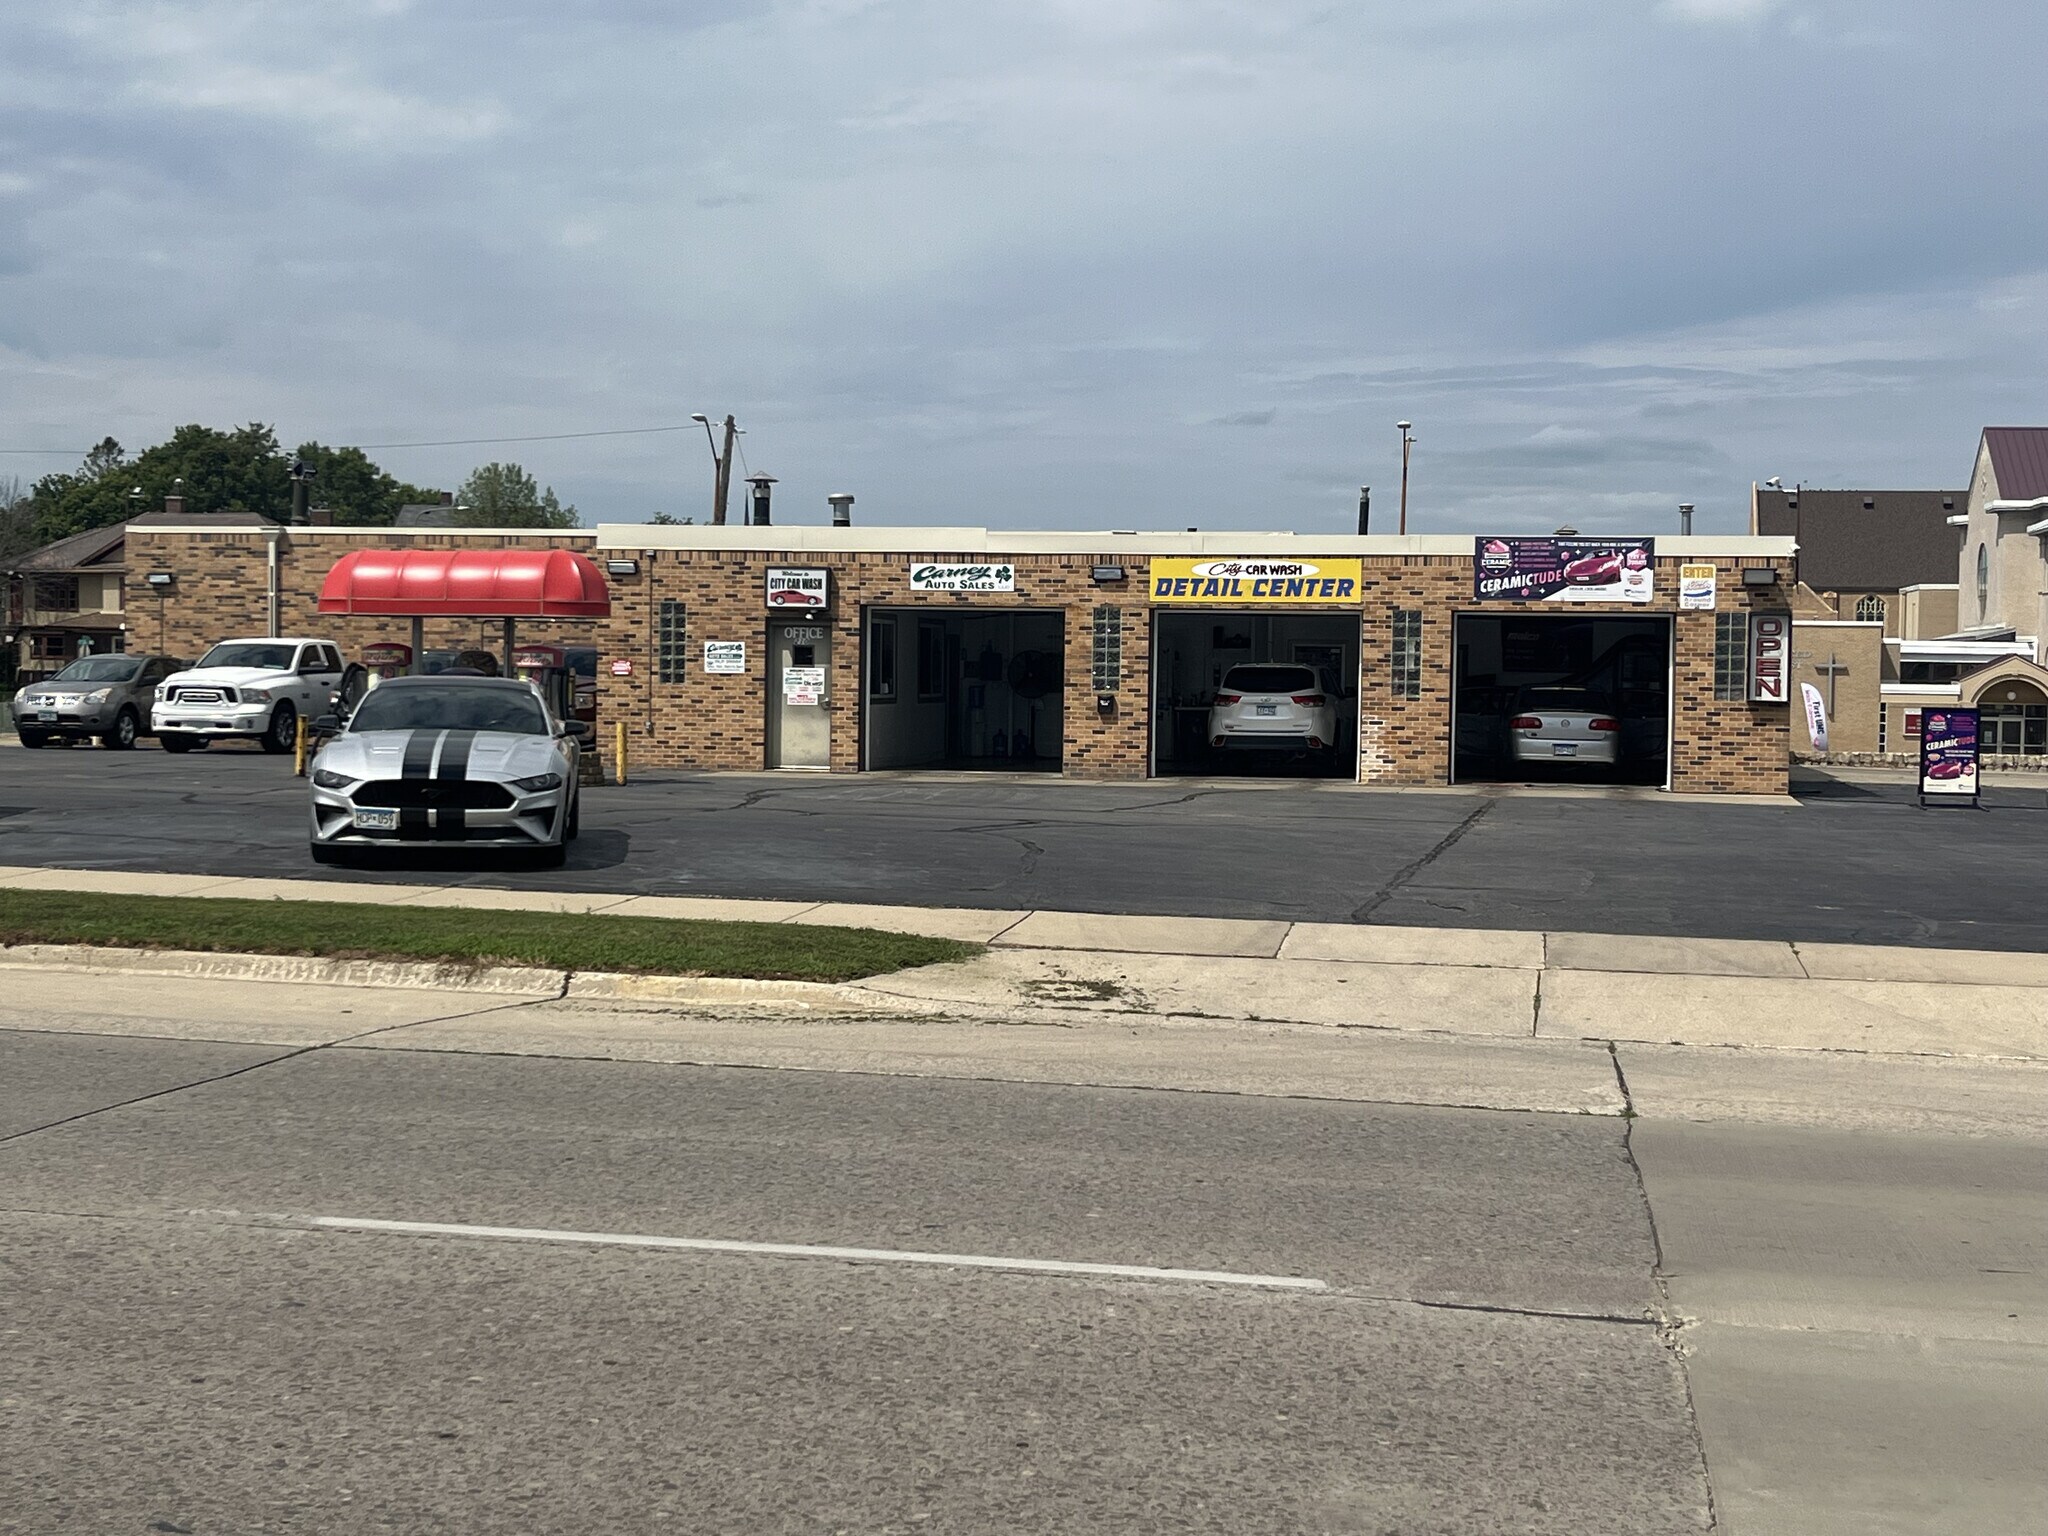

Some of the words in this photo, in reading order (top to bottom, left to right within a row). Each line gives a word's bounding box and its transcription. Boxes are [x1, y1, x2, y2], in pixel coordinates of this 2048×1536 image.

[912, 566, 991, 582] Carney
[1209, 563, 1246, 576] City
[1246, 564, 1267, 575] CAR
[1269, 564, 1302, 576] WASH
[1683, 567, 1714, 578] ENTER
[770, 578, 786, 589] CITY
[787, 578, 801, 589] CAR
[802, 578, 823, 589] WASH
[925, 580, 955, 589] AUTO
[960, 580, 995, 590] SALES
[1155, 578, 1243, 597] DETAIL
[1252, 578, 1355, 597] CENTER
[1480, 569, 1562, 593] CERAMICTUDE
[784, 627, 824, 638] OFFICE
[1756, 618, 1782, 697] OPEN
[1812, 701, 1822, 718] First
[1815, 719, 1825, 735] UMC
